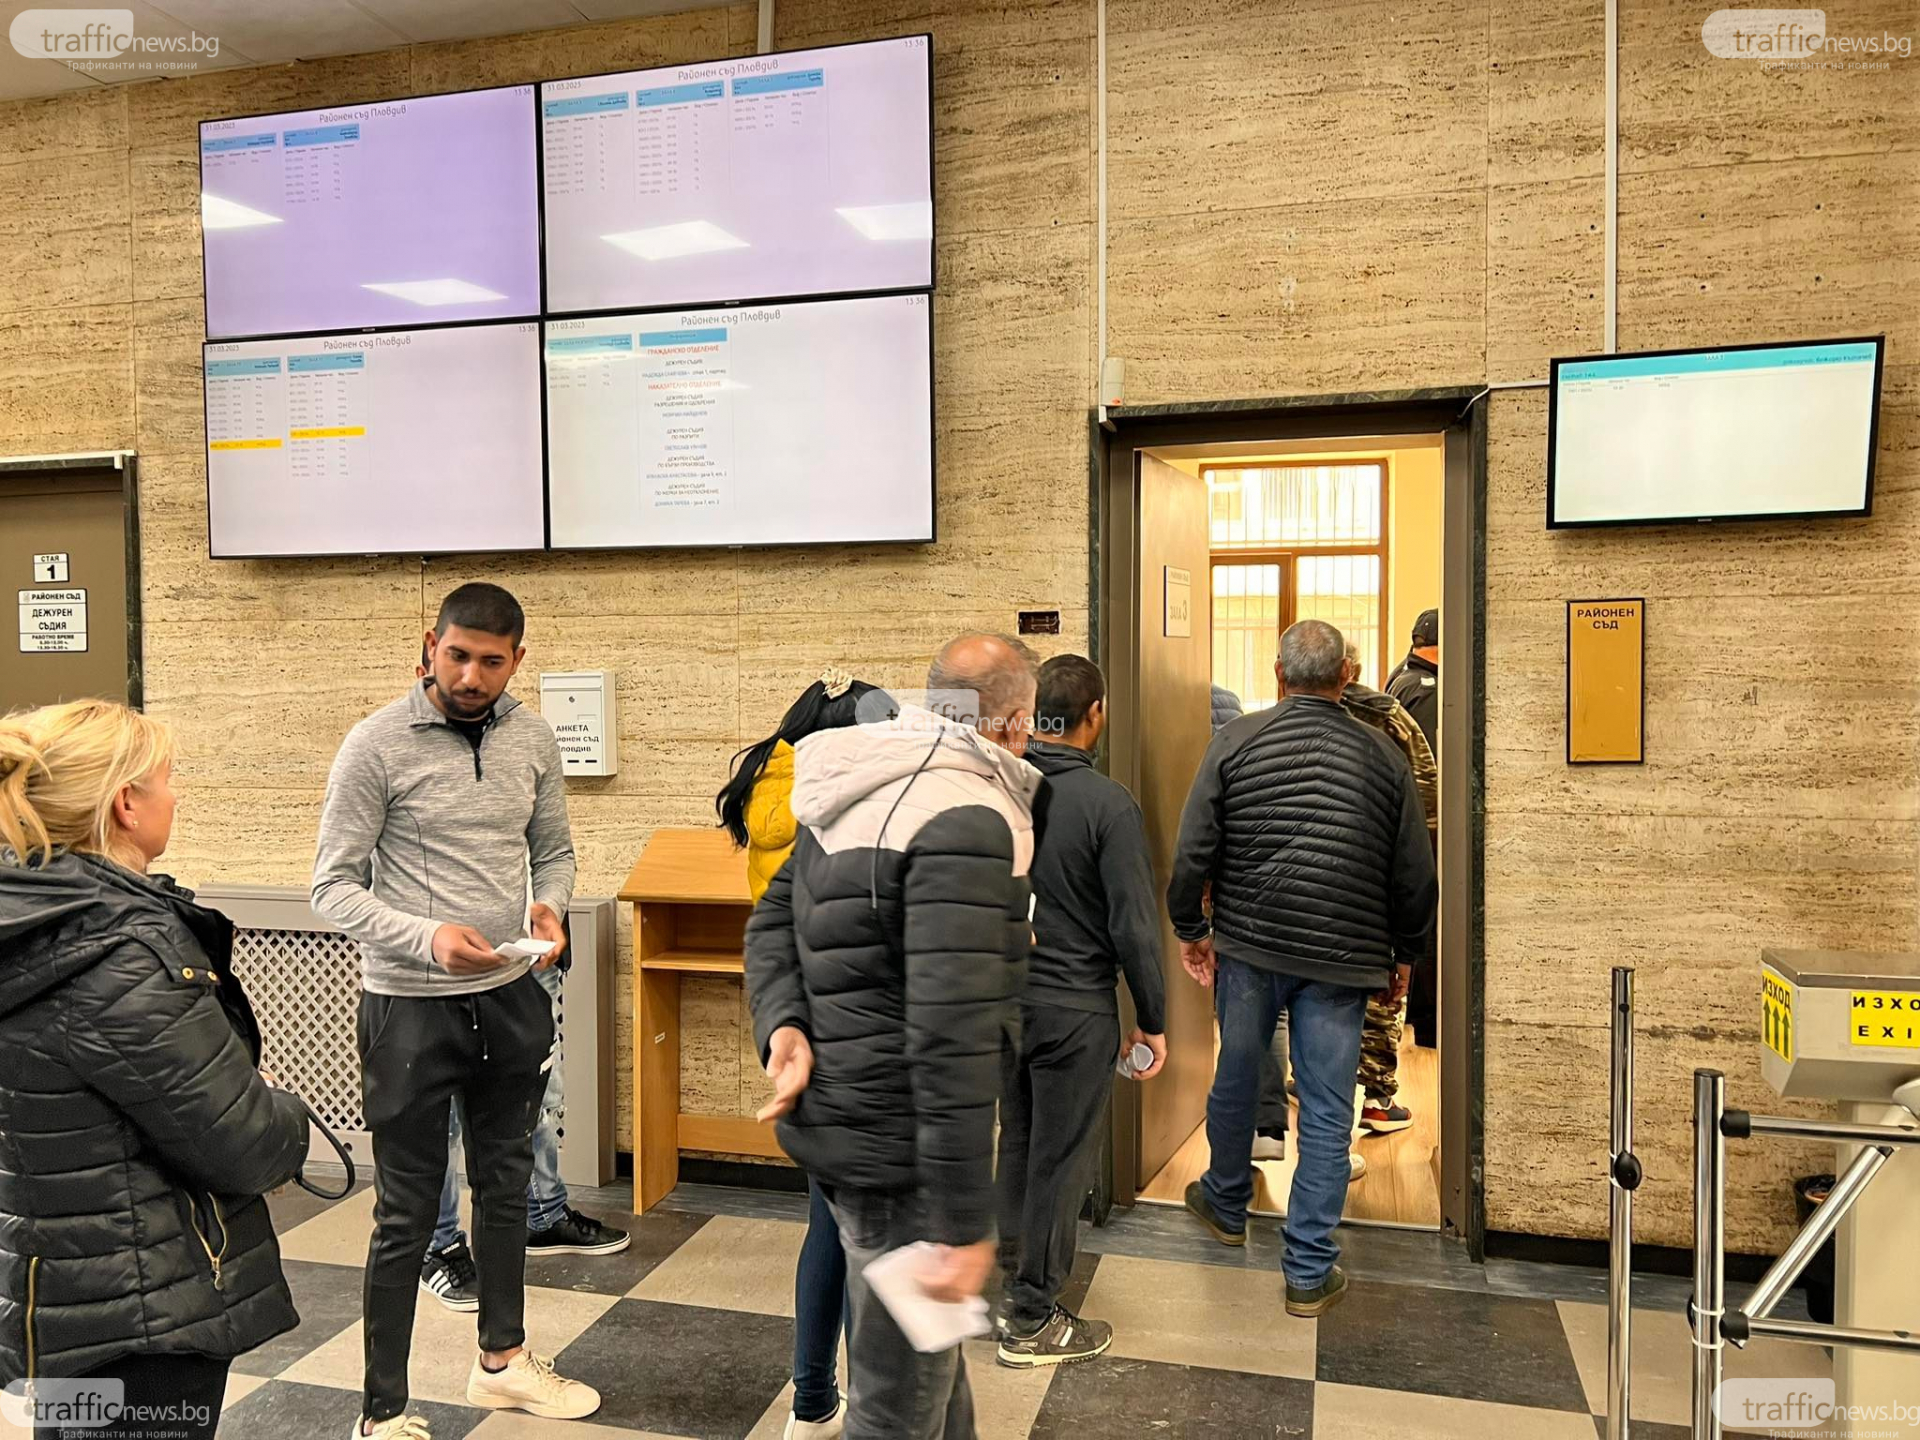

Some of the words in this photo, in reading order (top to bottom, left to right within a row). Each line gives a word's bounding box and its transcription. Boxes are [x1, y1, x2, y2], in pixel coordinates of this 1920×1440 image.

[678, 67, 716, 82] Районен
[719, 64, 735, 76] съд
[737, 58, 779, 74] Пловдив
[319, 112, 353, 123] Районен
[354, 110, 369, 120] съд
[371, 105, 407, 117] Пловдив
[681, 312, 719, 326] Районен
[722, 311, 739, 325] съд
[740, 309, 781, 323] Пловдив
[323, 338, 357, 350] Районен
[359, 337, 374, 349] съд
[375, 334, 411, 348] Пловдив
[47, 564, 55, 579] 1
[32, 592, 65, 600] РАЙОНЕН
[66, 592, 81, 600] СЪД
[32, 608, 73, 618] ДЕЖУРЕН
[1577, 607, 1635, 618] РАЙОНЕН
[38, 621, 67, 631] СЪДИЯ
[1592, 620, 1619, 630] СЪД
[556, 724, 589, 732] АНКЕТА
[1762, 975, 1791, 1013] ИЗХОД
[1853, 997, 1920, 1011] ИЗХО
[1858, 1025, 1912, 1039] EXI
